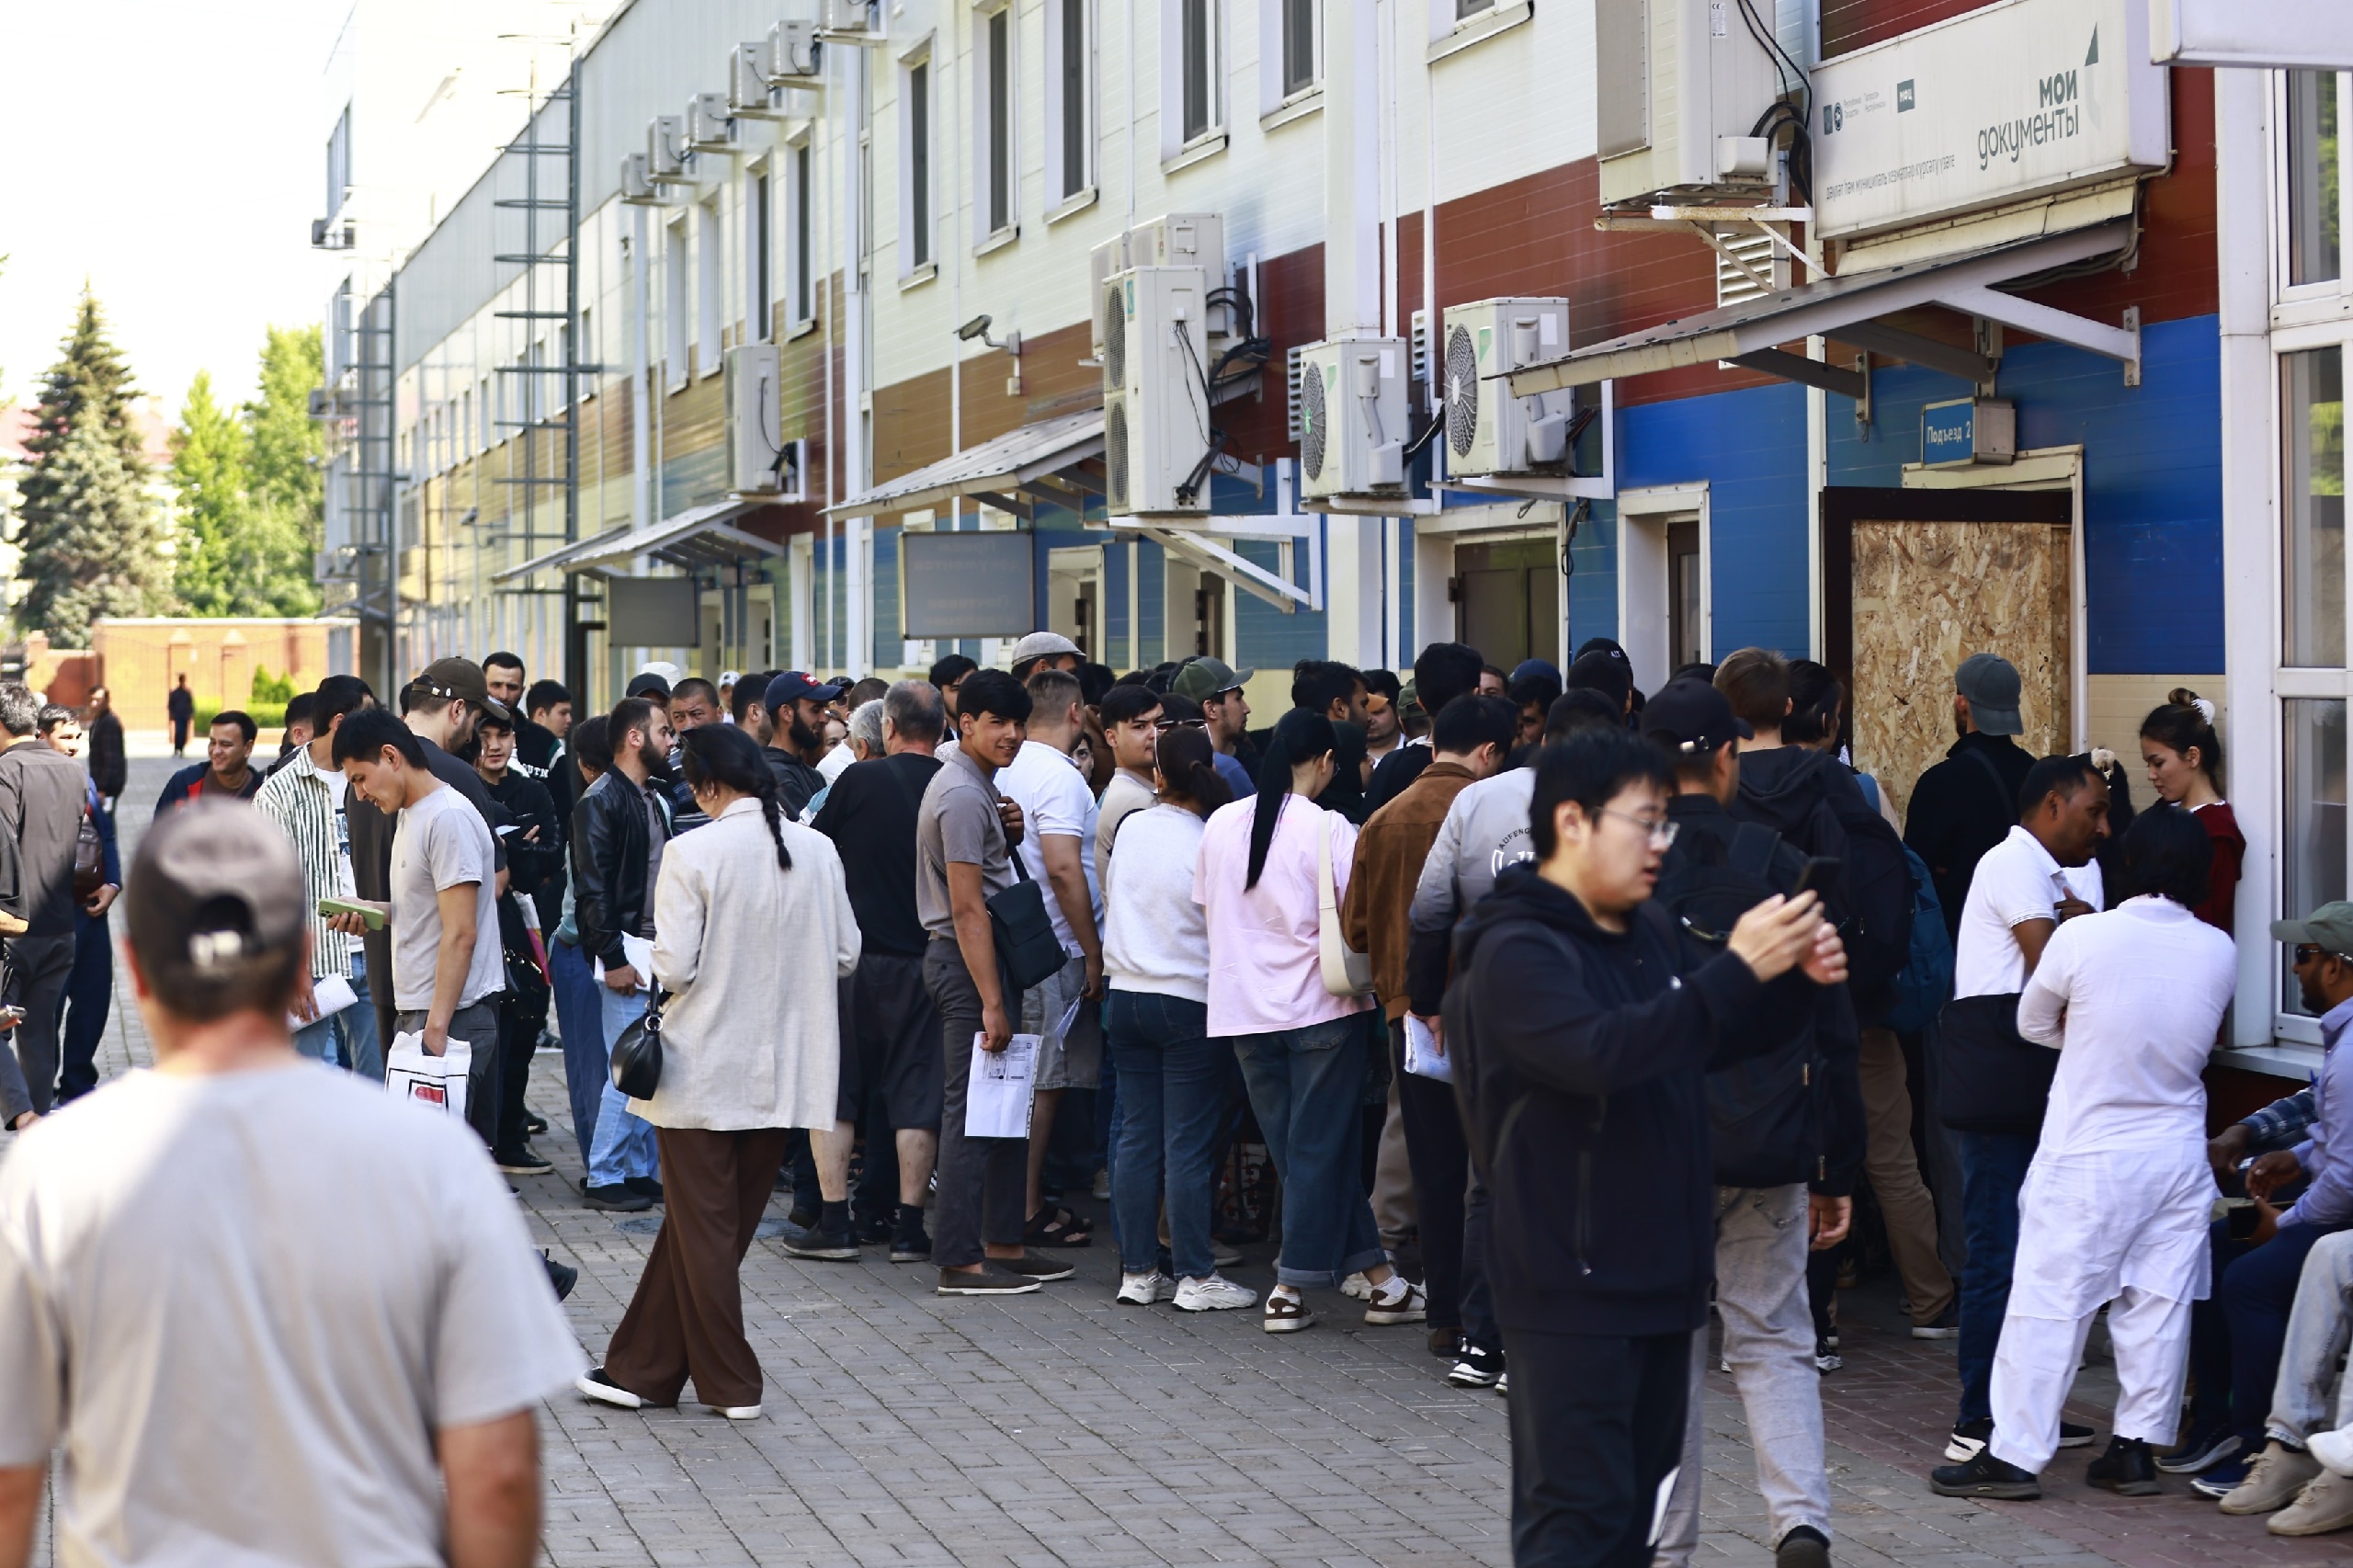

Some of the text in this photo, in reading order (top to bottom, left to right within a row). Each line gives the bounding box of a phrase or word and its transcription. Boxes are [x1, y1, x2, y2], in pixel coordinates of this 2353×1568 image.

[2039, 69, 2078, 108] мои
[1978, 105, 2079, 171] документы
[1927, 421, 1972, 445] Подъезд 2
